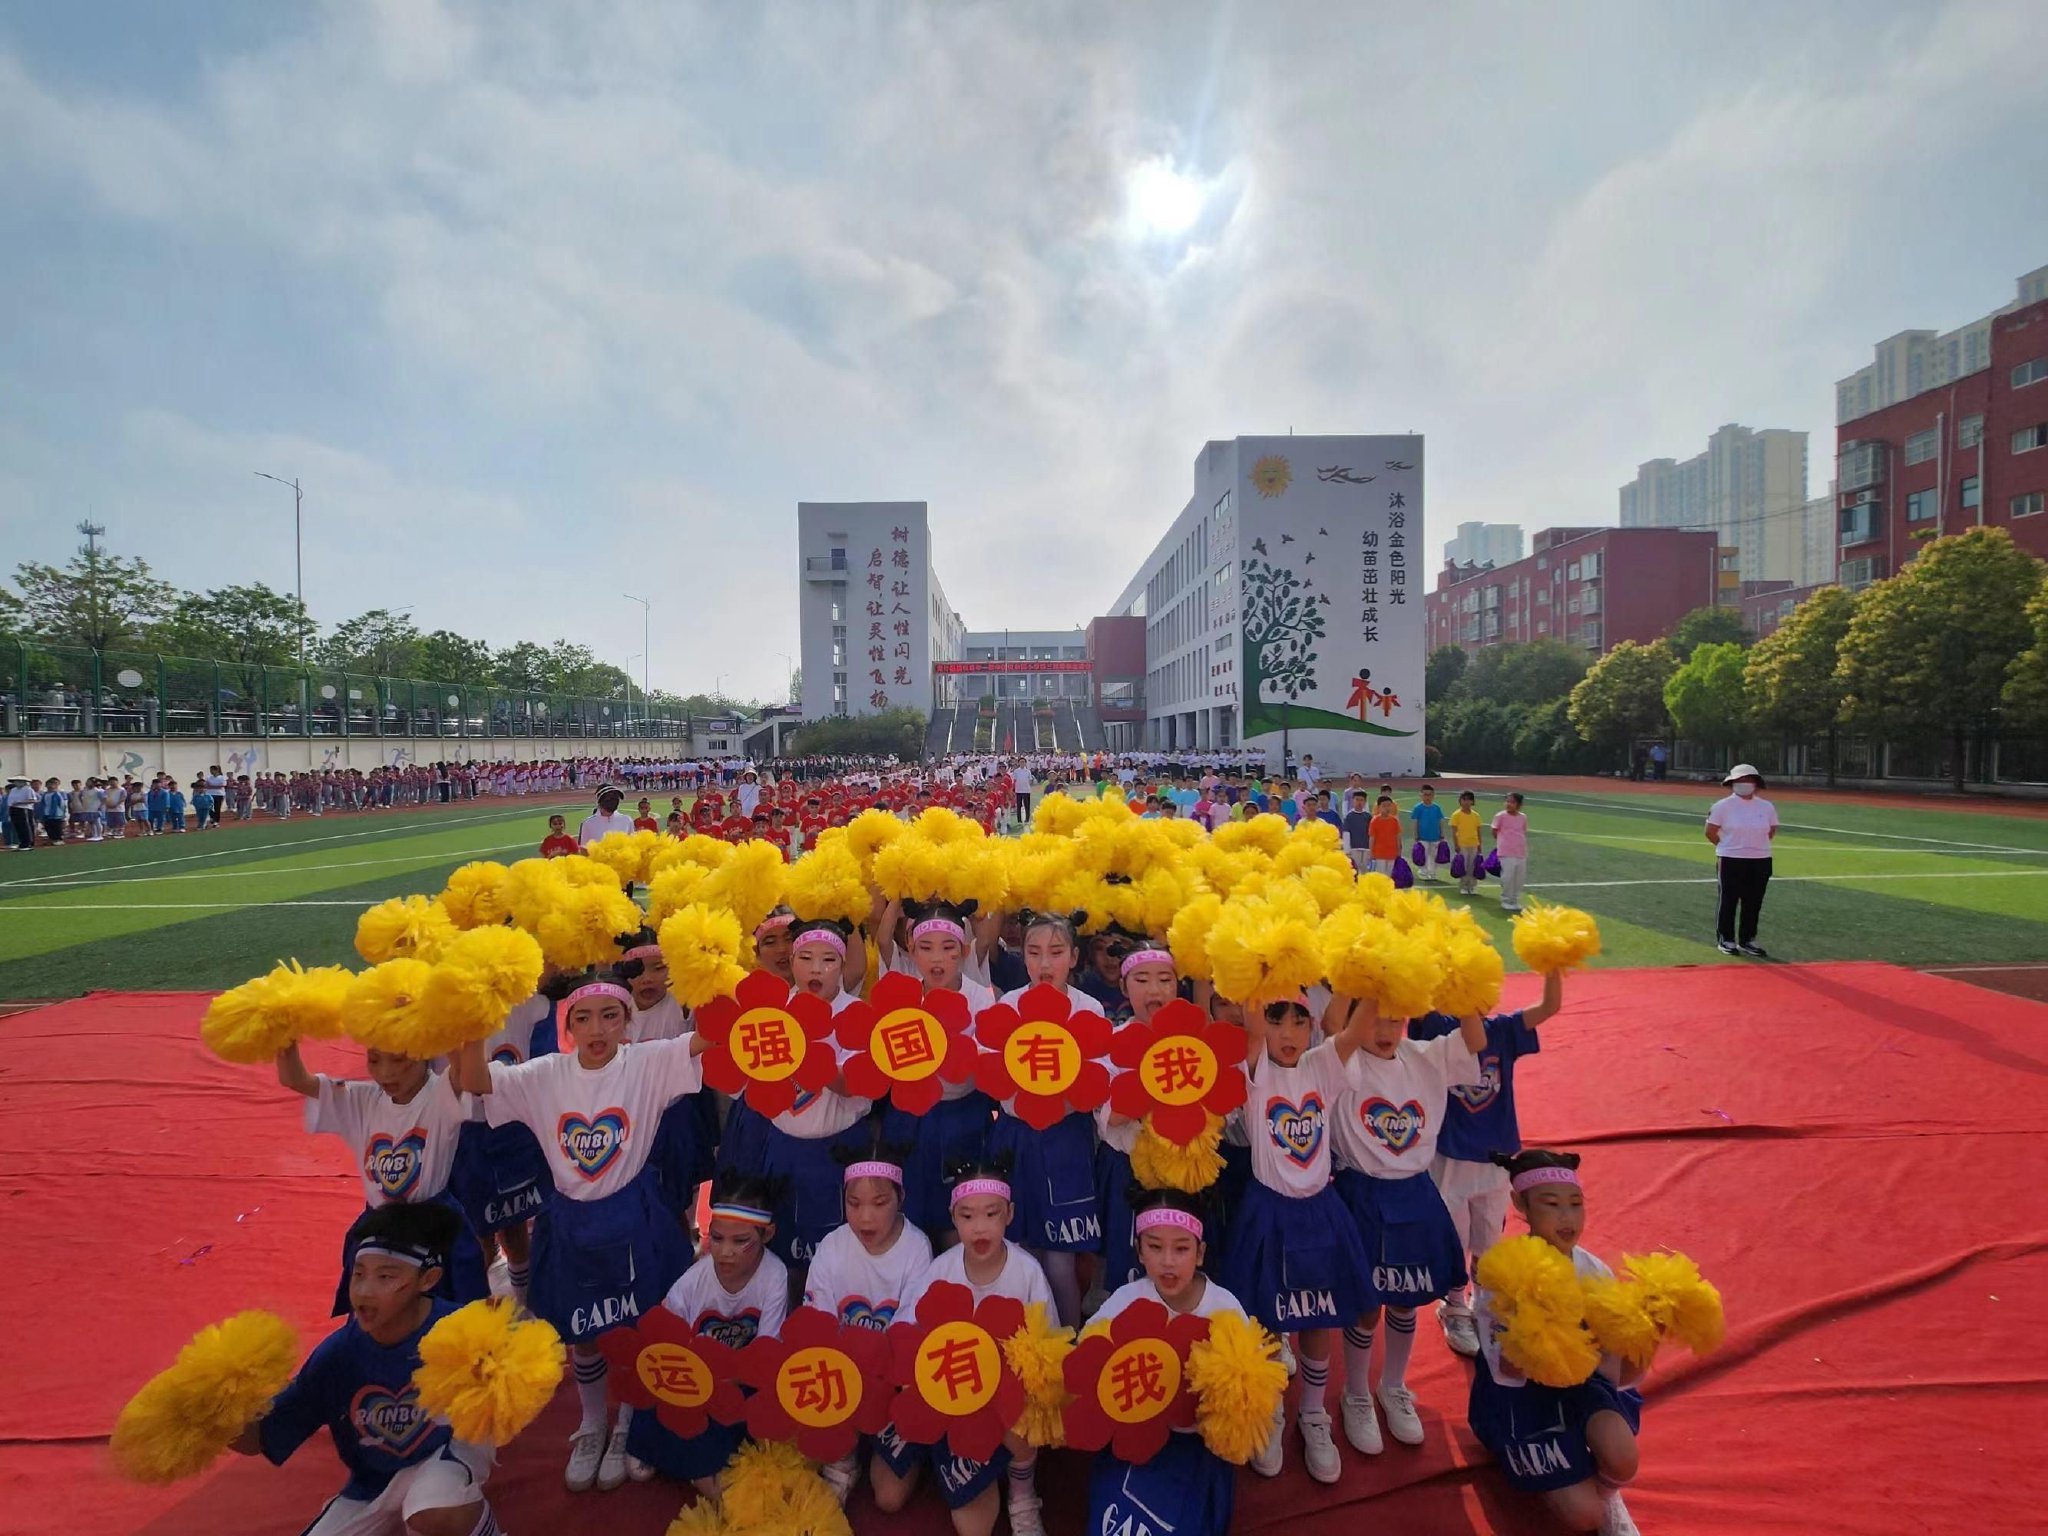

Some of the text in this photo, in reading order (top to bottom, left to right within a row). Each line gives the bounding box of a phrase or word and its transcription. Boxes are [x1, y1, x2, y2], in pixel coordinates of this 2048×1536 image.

[1388, 492, 1406, 605] 沐浴金色阳光
[1362, 531, 1379, 643] 幼苗茁壮成长
[739, 1018, 1204, 1094] 强 国 有 我
[484, 1185, 543, 1224] GARM
[1045, 1216, 1101, 1243] GARM
[1372, 1264, 1434, 1293] GRAM
[571, 1291, 639, 1335] GARM
[1275, 1290, 1337, 1321] GARM
[645, 1338, 1168, 1414] 运 动 有 我
[1506, 1437, 1571, 1477] GARM
